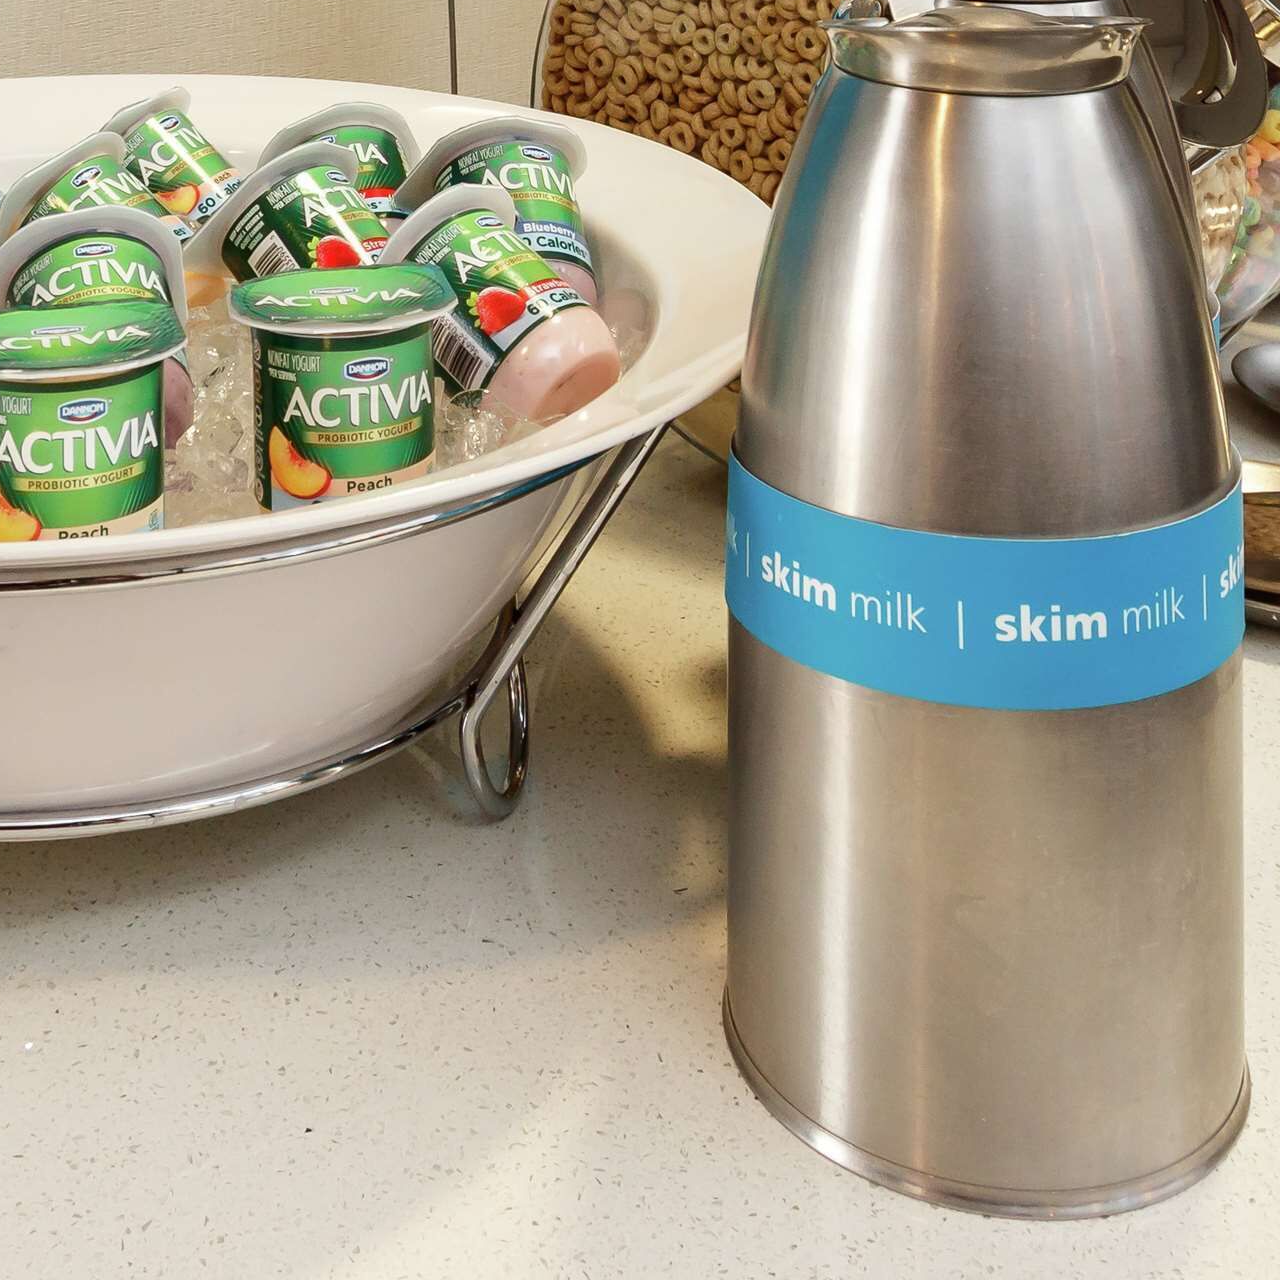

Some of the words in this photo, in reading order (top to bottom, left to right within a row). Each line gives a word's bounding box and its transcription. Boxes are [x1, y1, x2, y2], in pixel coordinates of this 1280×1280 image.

[214, 172, 232, 185] each
[197, 197, 217, 214] 60
[523, 222, 576, 239] Blueberry
[31, 258, 170, 308] ACTIVIA
[255, 287, 423, 308] ACTIVIA
[291, 354, 321, 374] YOGURT
[348, 360, 388, 375] DANNON
[1, 397, 32, 416] YOGURT
[283, 370, 432, 428] ACTIVIA
[63, 402, 105, 417] DANNON
[317, 430, 375, 444] PROBIOTIC
[377, 421, 415, 439] YOGURT
[28, 475, 89, 491] PROBIOTIC
[93, 466, 134, 485] YOGURT
[346, 475, 393, 494] Peach
[761, 551, 837, 612] skim
[851, 589, 928, 634] milk
[995, 604, 1108, 643] skim
[1123, 586, 1185, 635] milk
